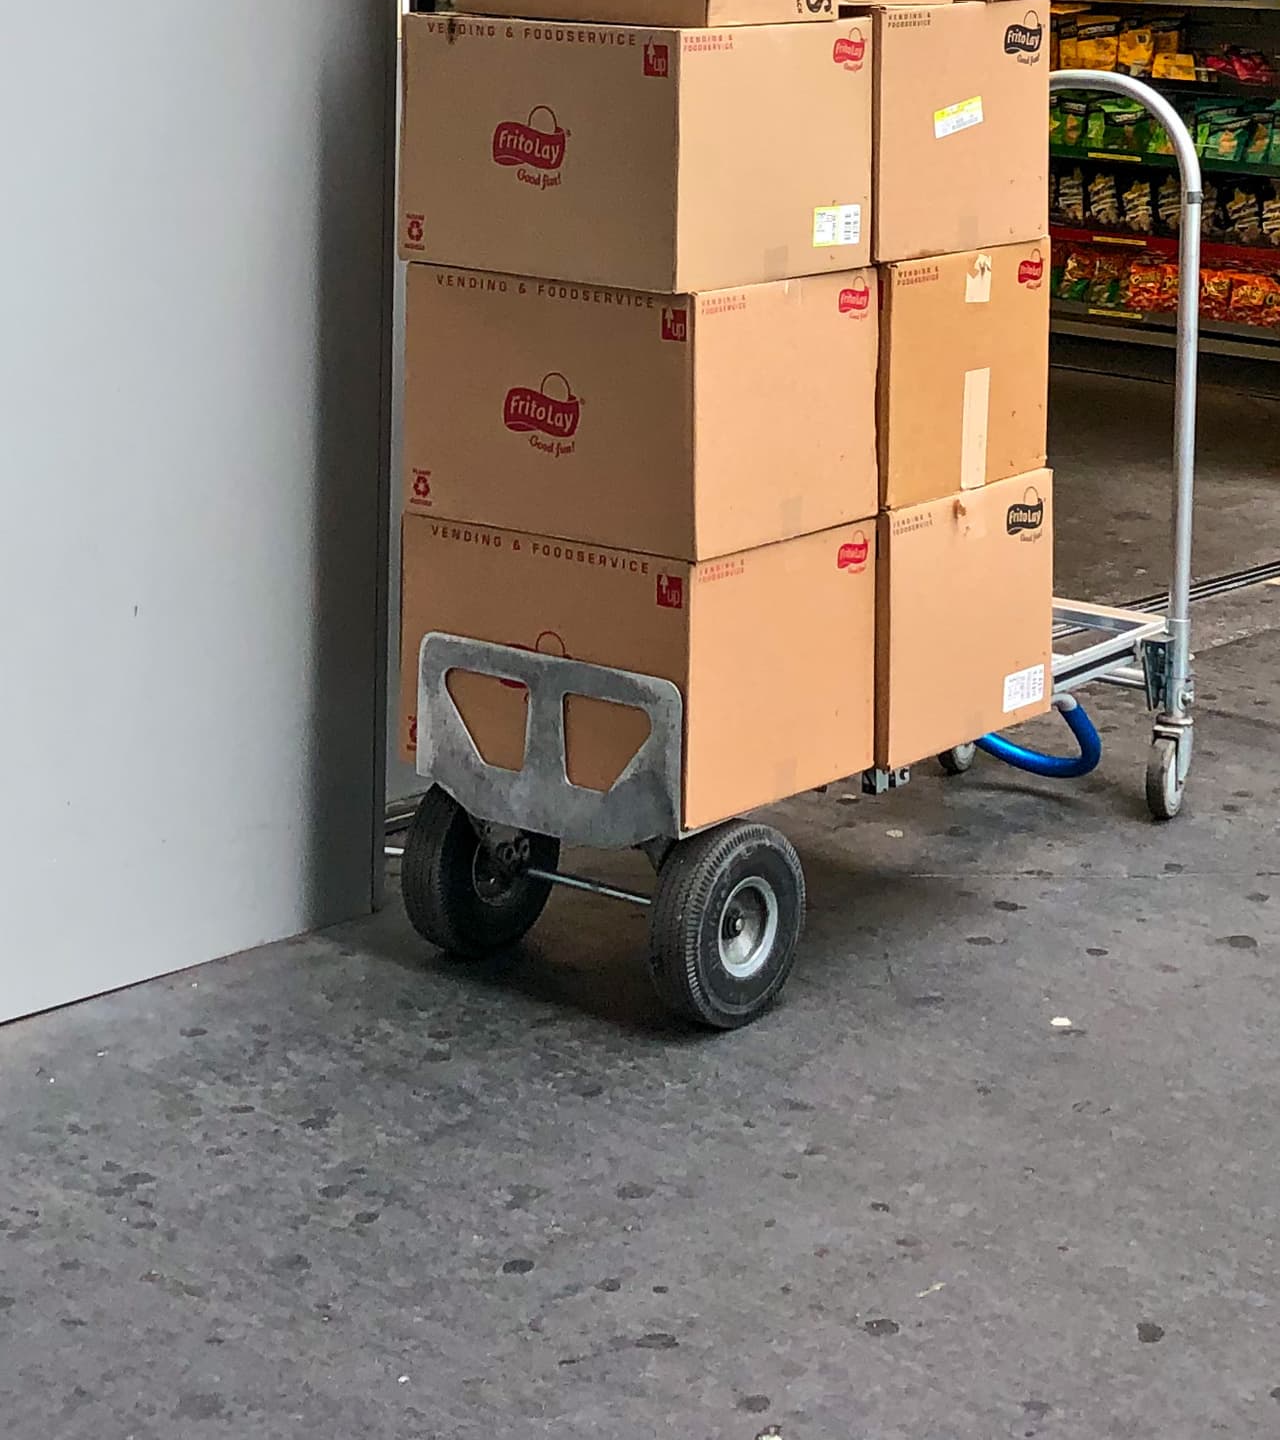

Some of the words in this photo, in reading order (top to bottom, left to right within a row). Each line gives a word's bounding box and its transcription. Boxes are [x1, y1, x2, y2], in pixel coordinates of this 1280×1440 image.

[888, 13, 922, 21] VENDING
[506, 28, 514, 39] &
[524, 27, 637, 47] FOODSERVICE
[684, 34, 723, 43] VENDING
[517, 168, 540, 186] Good
[436, 274, 508, 293] VENDING
[518, 283, 527, 294] &
[537, 284, 656, 309] FOODSERVICE
[529, 435, 554, 454] Good
[554, 440, 575, 459] fun!
[431, 524, 503, 548] VENDING
[512, 539, 521, 550] &
[532, 542, 650, 575] FOODSERVICE
